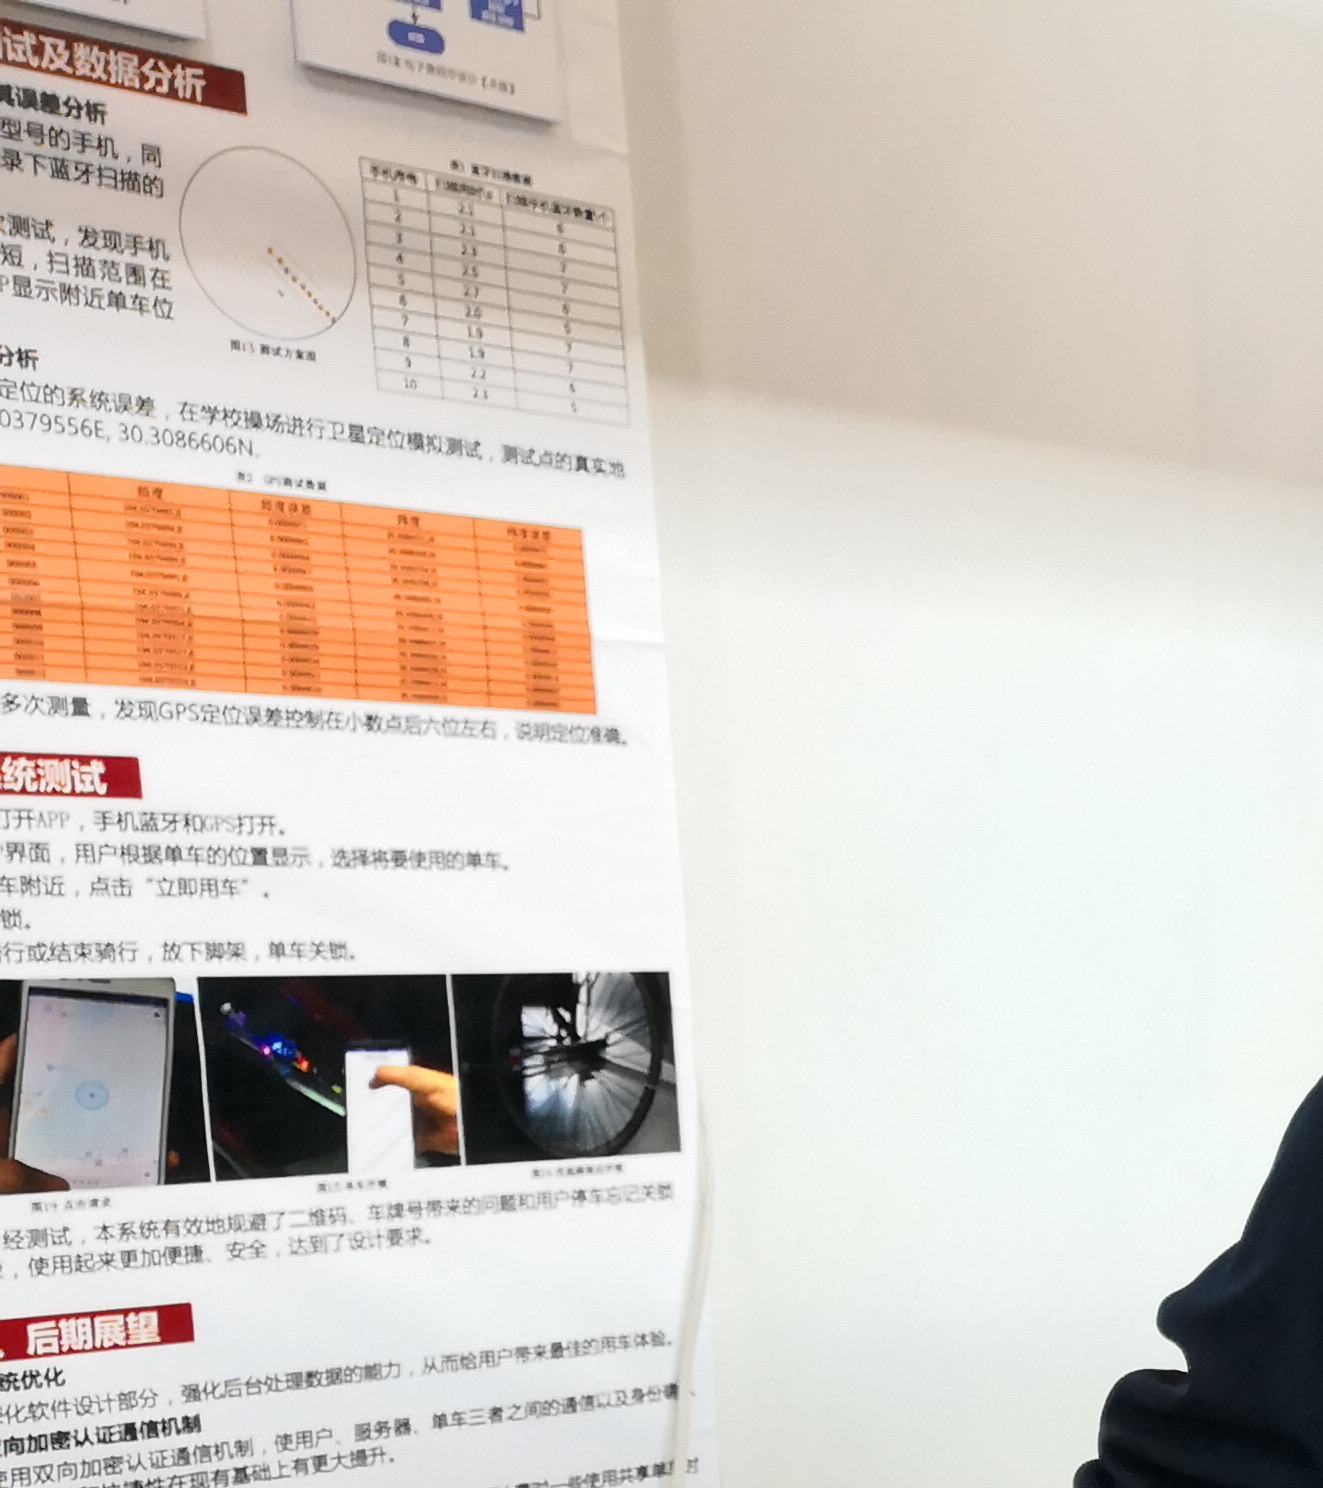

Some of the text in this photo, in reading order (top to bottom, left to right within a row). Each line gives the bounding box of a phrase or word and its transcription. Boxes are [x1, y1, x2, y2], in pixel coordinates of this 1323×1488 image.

[0, 25, 207, 103] 试及数据分析
[0, 213, 170, 262] 测试，发现手机
[0, 756, 108, 796] 统测试
[26, 1310, 162, 1357] 后期展望
[0, 1413, 202, 1458] 向加密认证通信机制
